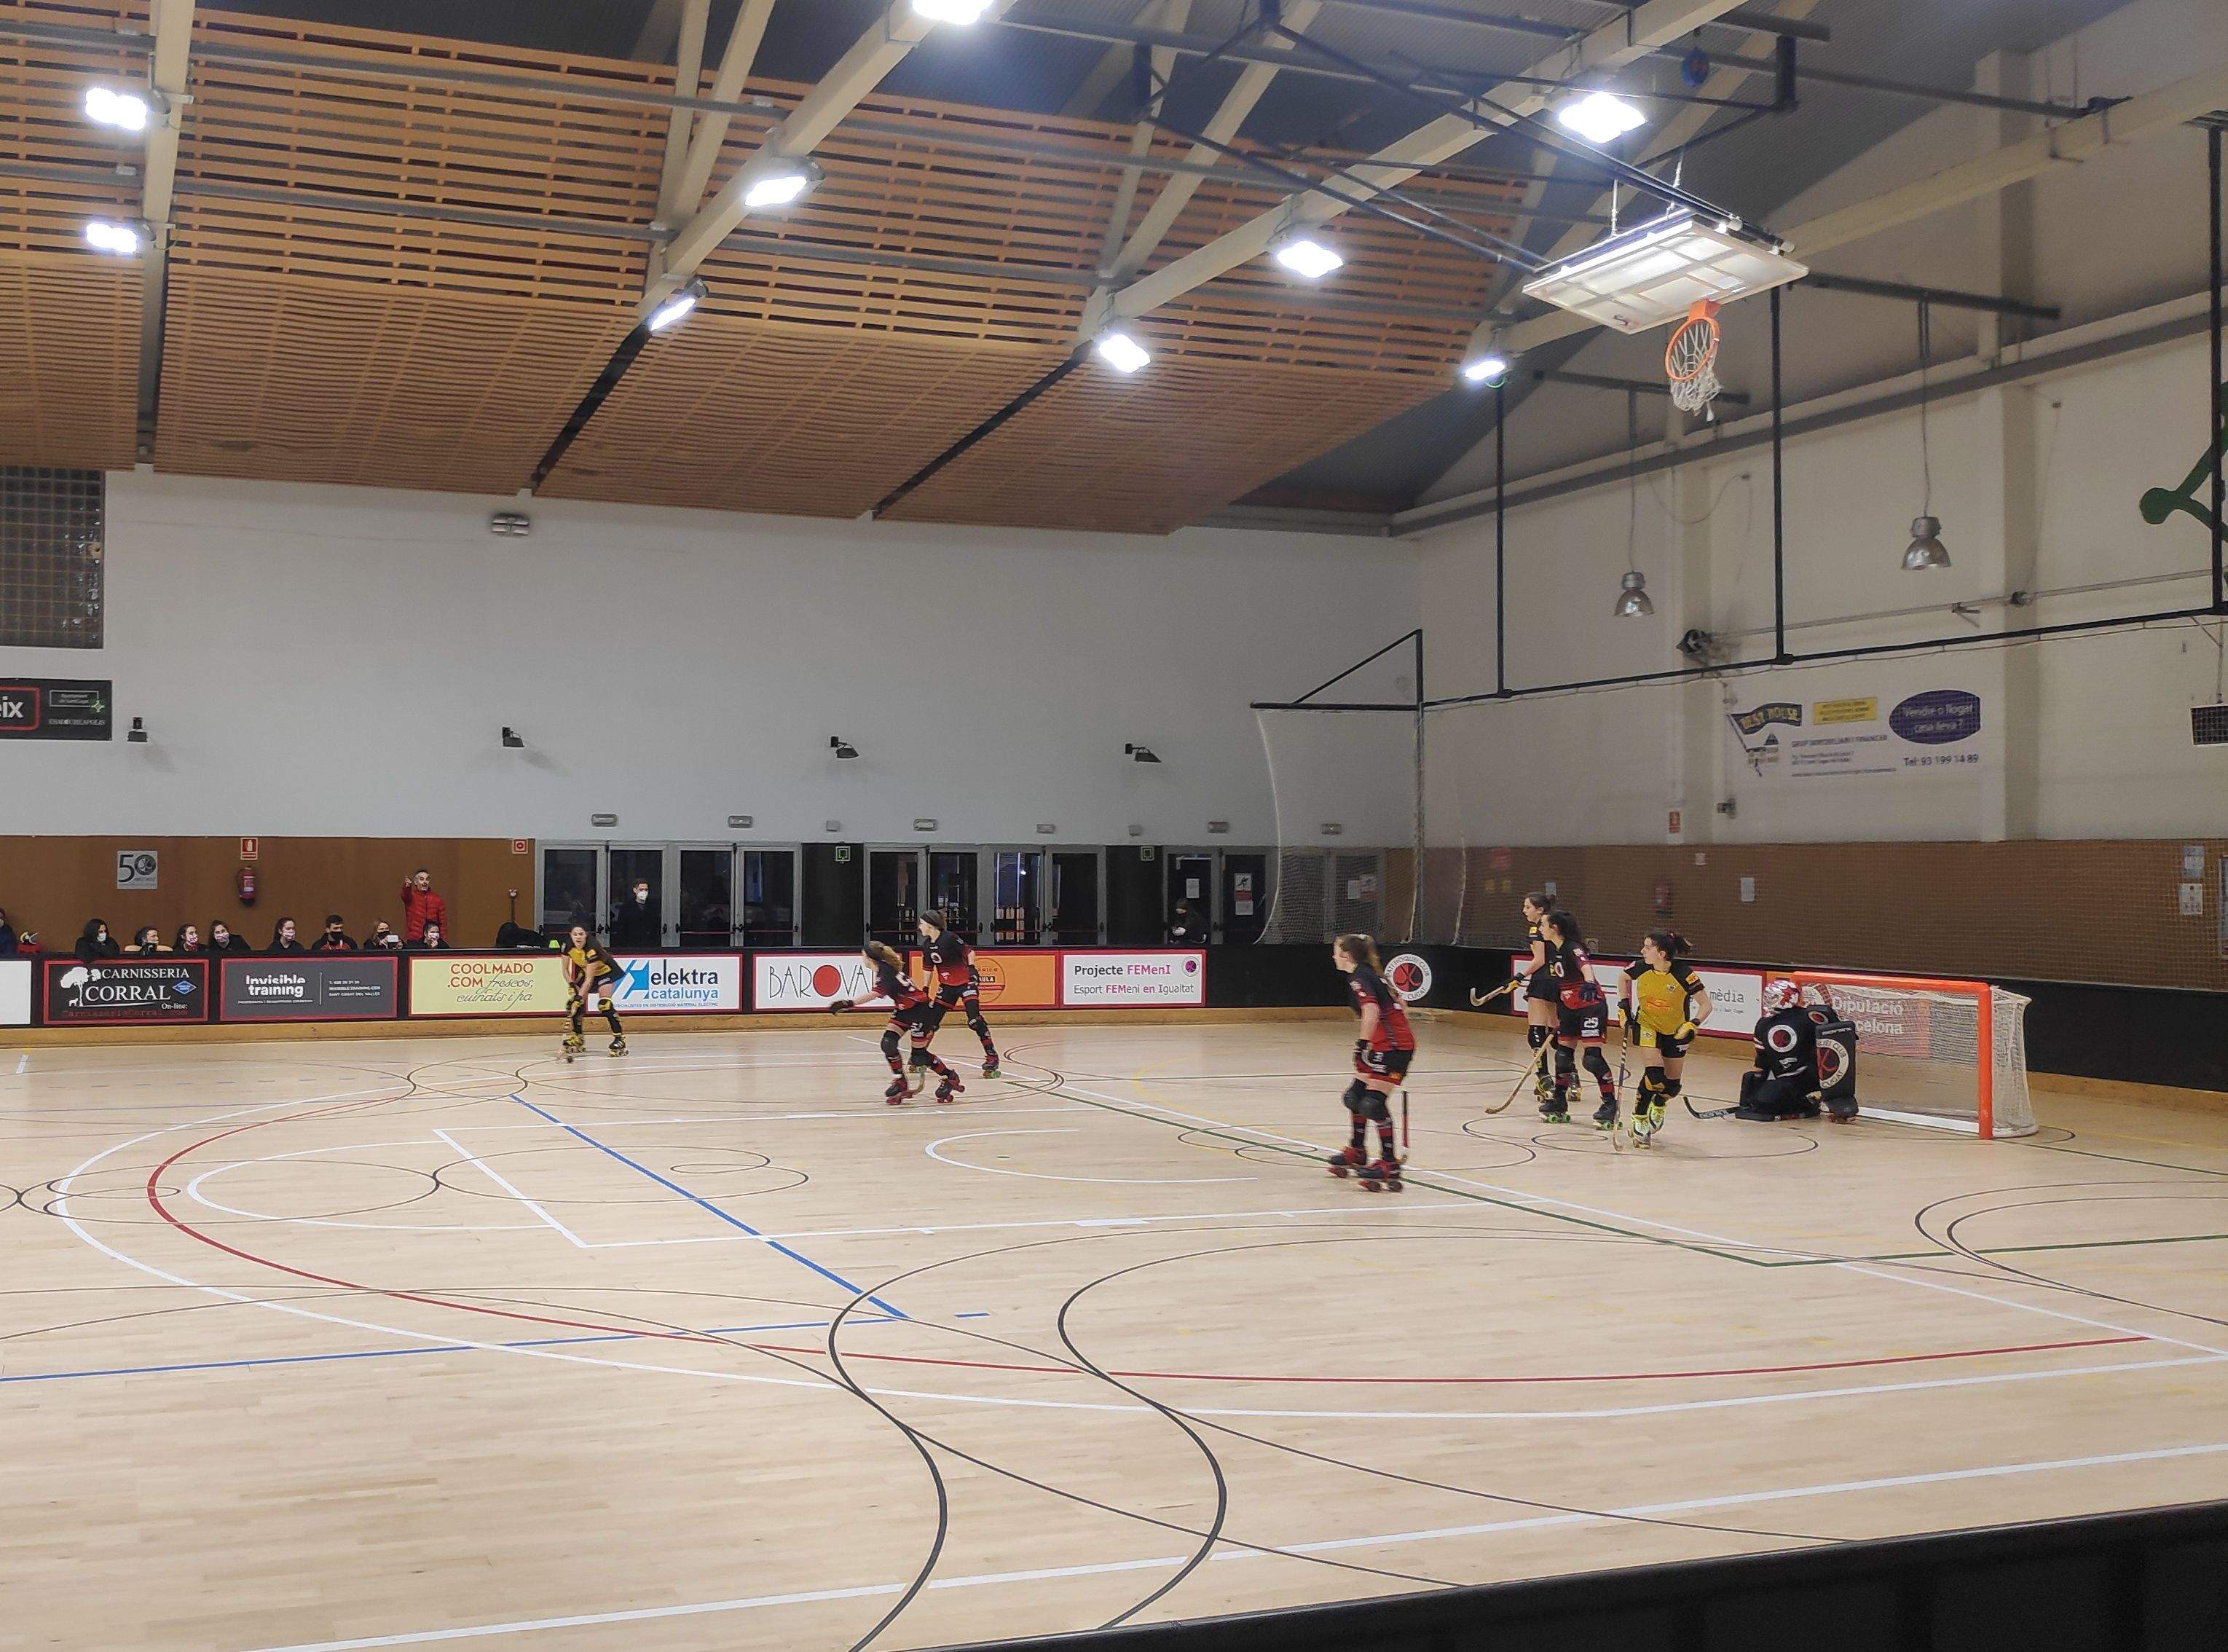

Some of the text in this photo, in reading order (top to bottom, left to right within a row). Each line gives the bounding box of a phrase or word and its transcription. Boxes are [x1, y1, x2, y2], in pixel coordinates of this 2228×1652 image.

[0, 696, 24, 718] ix
[101, 967, 190, 979] CARNISSERIA
[450, 962, 534, 975] COOLMADO
[651, 959, 718, 985] elektra
[1074, 964, 1171, 978] Projecte FEMenI
[245, 974, 306, 985] Invisible
[447, 976, 484, 988] .COM
[85, 985, 171, 1002] CORRAL
[248, 984, 304, 998] training
[651, 987, 718, 1002] catalunya
[1074, 983, 1194, 996] Esport FEMeni en Igualtat
[1709, 988, 1744, 1003] mèdia
